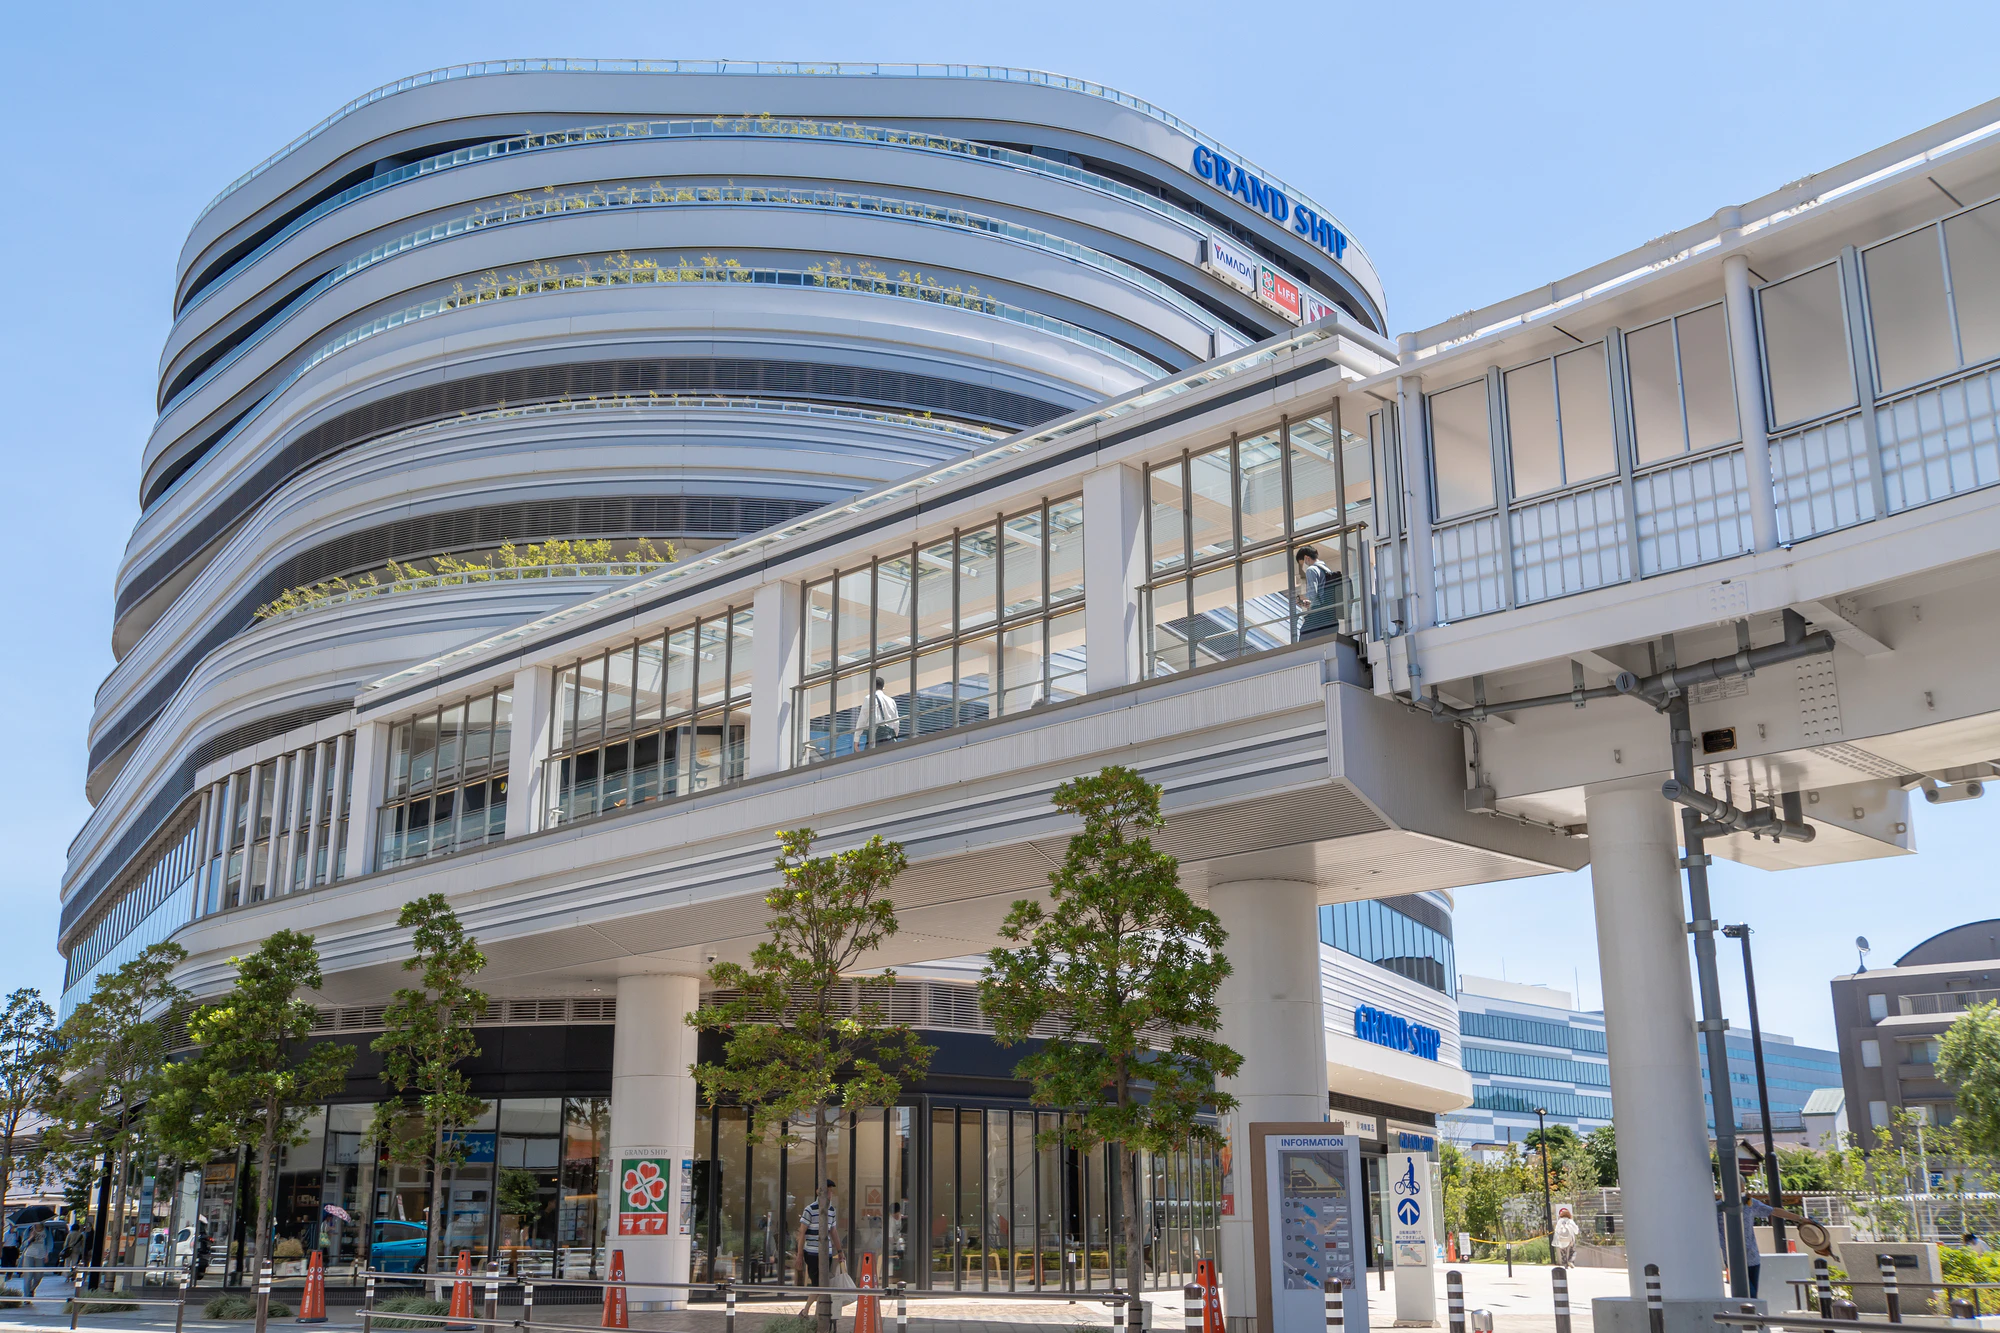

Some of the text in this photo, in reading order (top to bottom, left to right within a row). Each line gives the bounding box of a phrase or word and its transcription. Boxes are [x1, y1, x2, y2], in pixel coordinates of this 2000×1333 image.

[1193, 145, 1348, 259] GRAND SHIP
[1213, 243, 1252, 280] YAMADA
[1277, 284, 1296, 303] LIFE
[1355, 1004, 1441, 1062] GRAND SHIP
[1281, 1138, 1344, 1147] INFORMATION
[1399, 1132, 1434, 1152] GRAND SHIP
[622, 1218, 665, 1230] ライフ
